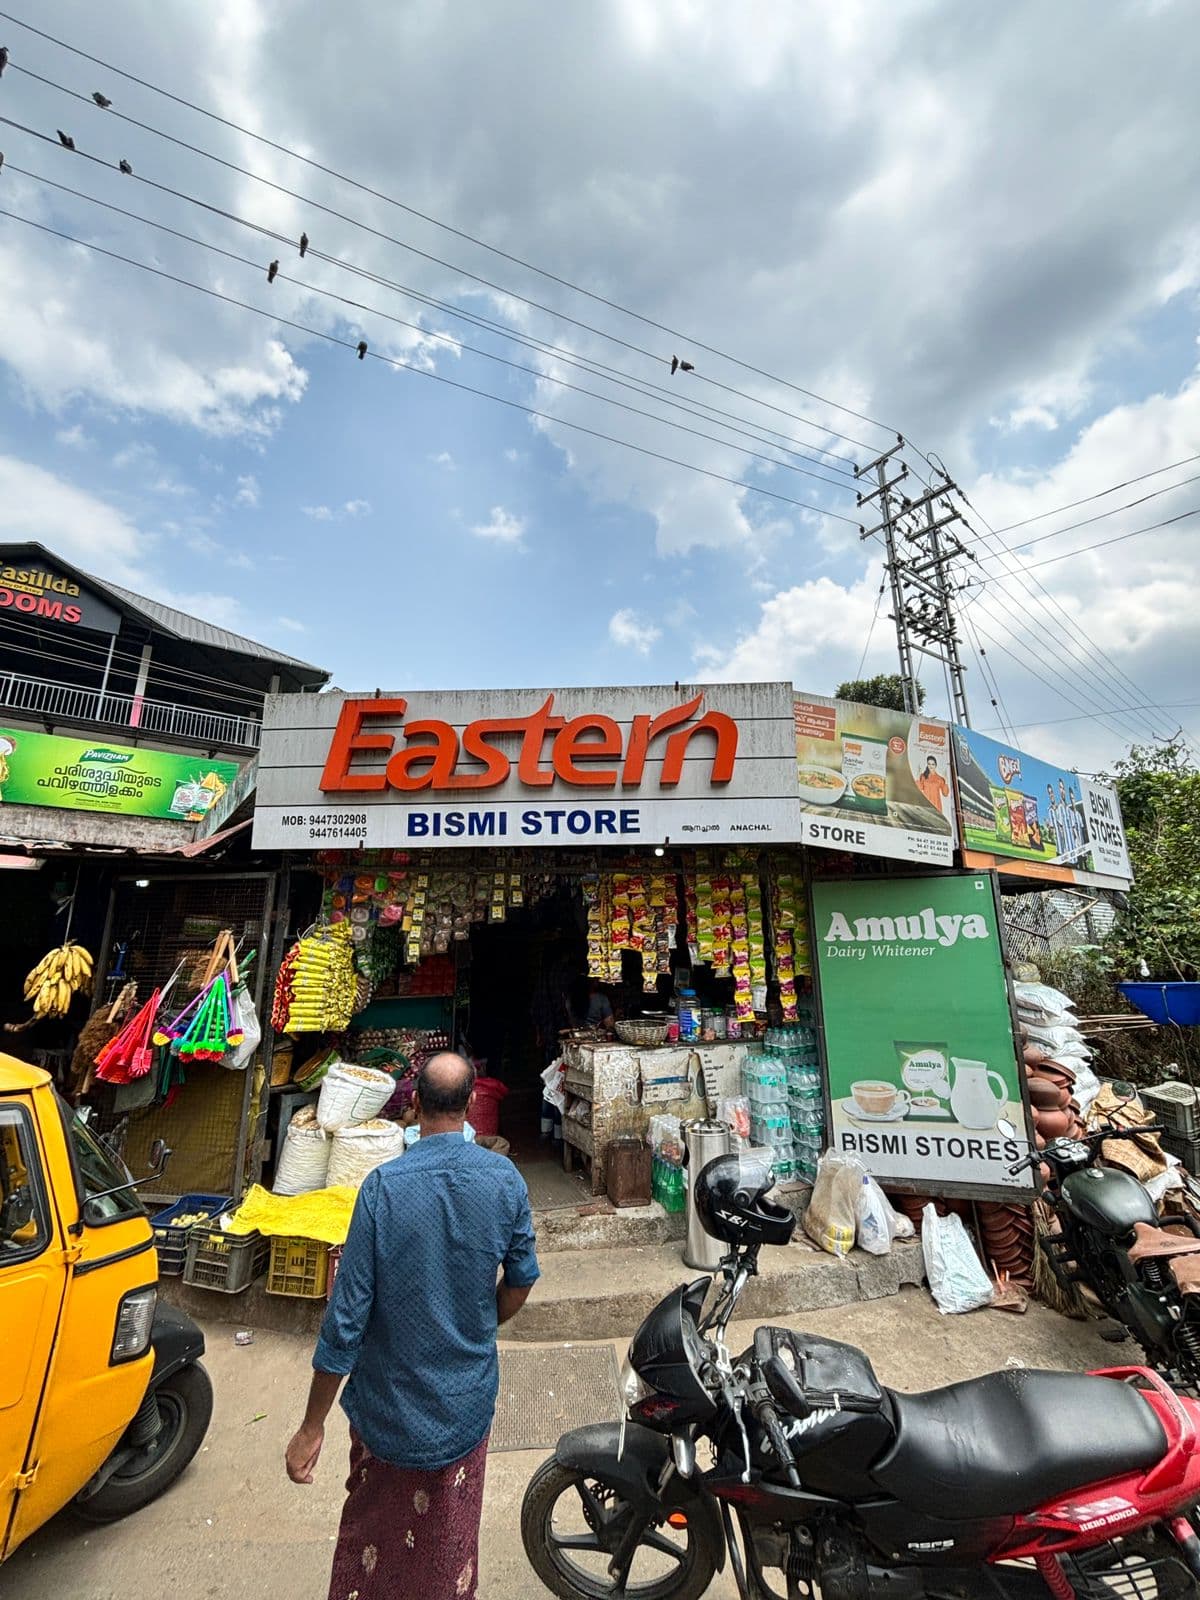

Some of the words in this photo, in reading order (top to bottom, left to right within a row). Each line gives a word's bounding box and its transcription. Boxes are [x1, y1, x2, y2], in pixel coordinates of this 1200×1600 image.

[0, 561, 80, 598] asillda
[318, 692, 739, 794] Eastern
[36, 776, 144, 798] പവിഴത്തിളക്കം
[54, 764, 162, 788] പരിശുദ്ധിയുടെ
[1089, 790, 1114, 820] BISMI
[281, 815, 307, 826] MOB:
[308, 814, 367, 825] 9447302908
[407, 811, 508, 837] BISMI
[521, 809, 640, 836] STORE
[729, 823, 772, 832] ANACHAL
[309, 827, 368, 838] 9447614405
[809, 823, 866, 846] STORE
[1090, 817, 1123, 848] STORES
[823, 908, 989, 946] Amulya
[826, 945, 866, 961] Dairy
[871, 944, 936, 957] Whitener
[908, 1060, 942, 1069] Amulya
[841, 1132, 908, 1155] BISMI
[915, 1135, 1020, 1162] STORES
[1079, 1517, 1107, 1532] HERO
[1105, 1507, 1140, 1524] HONDA
